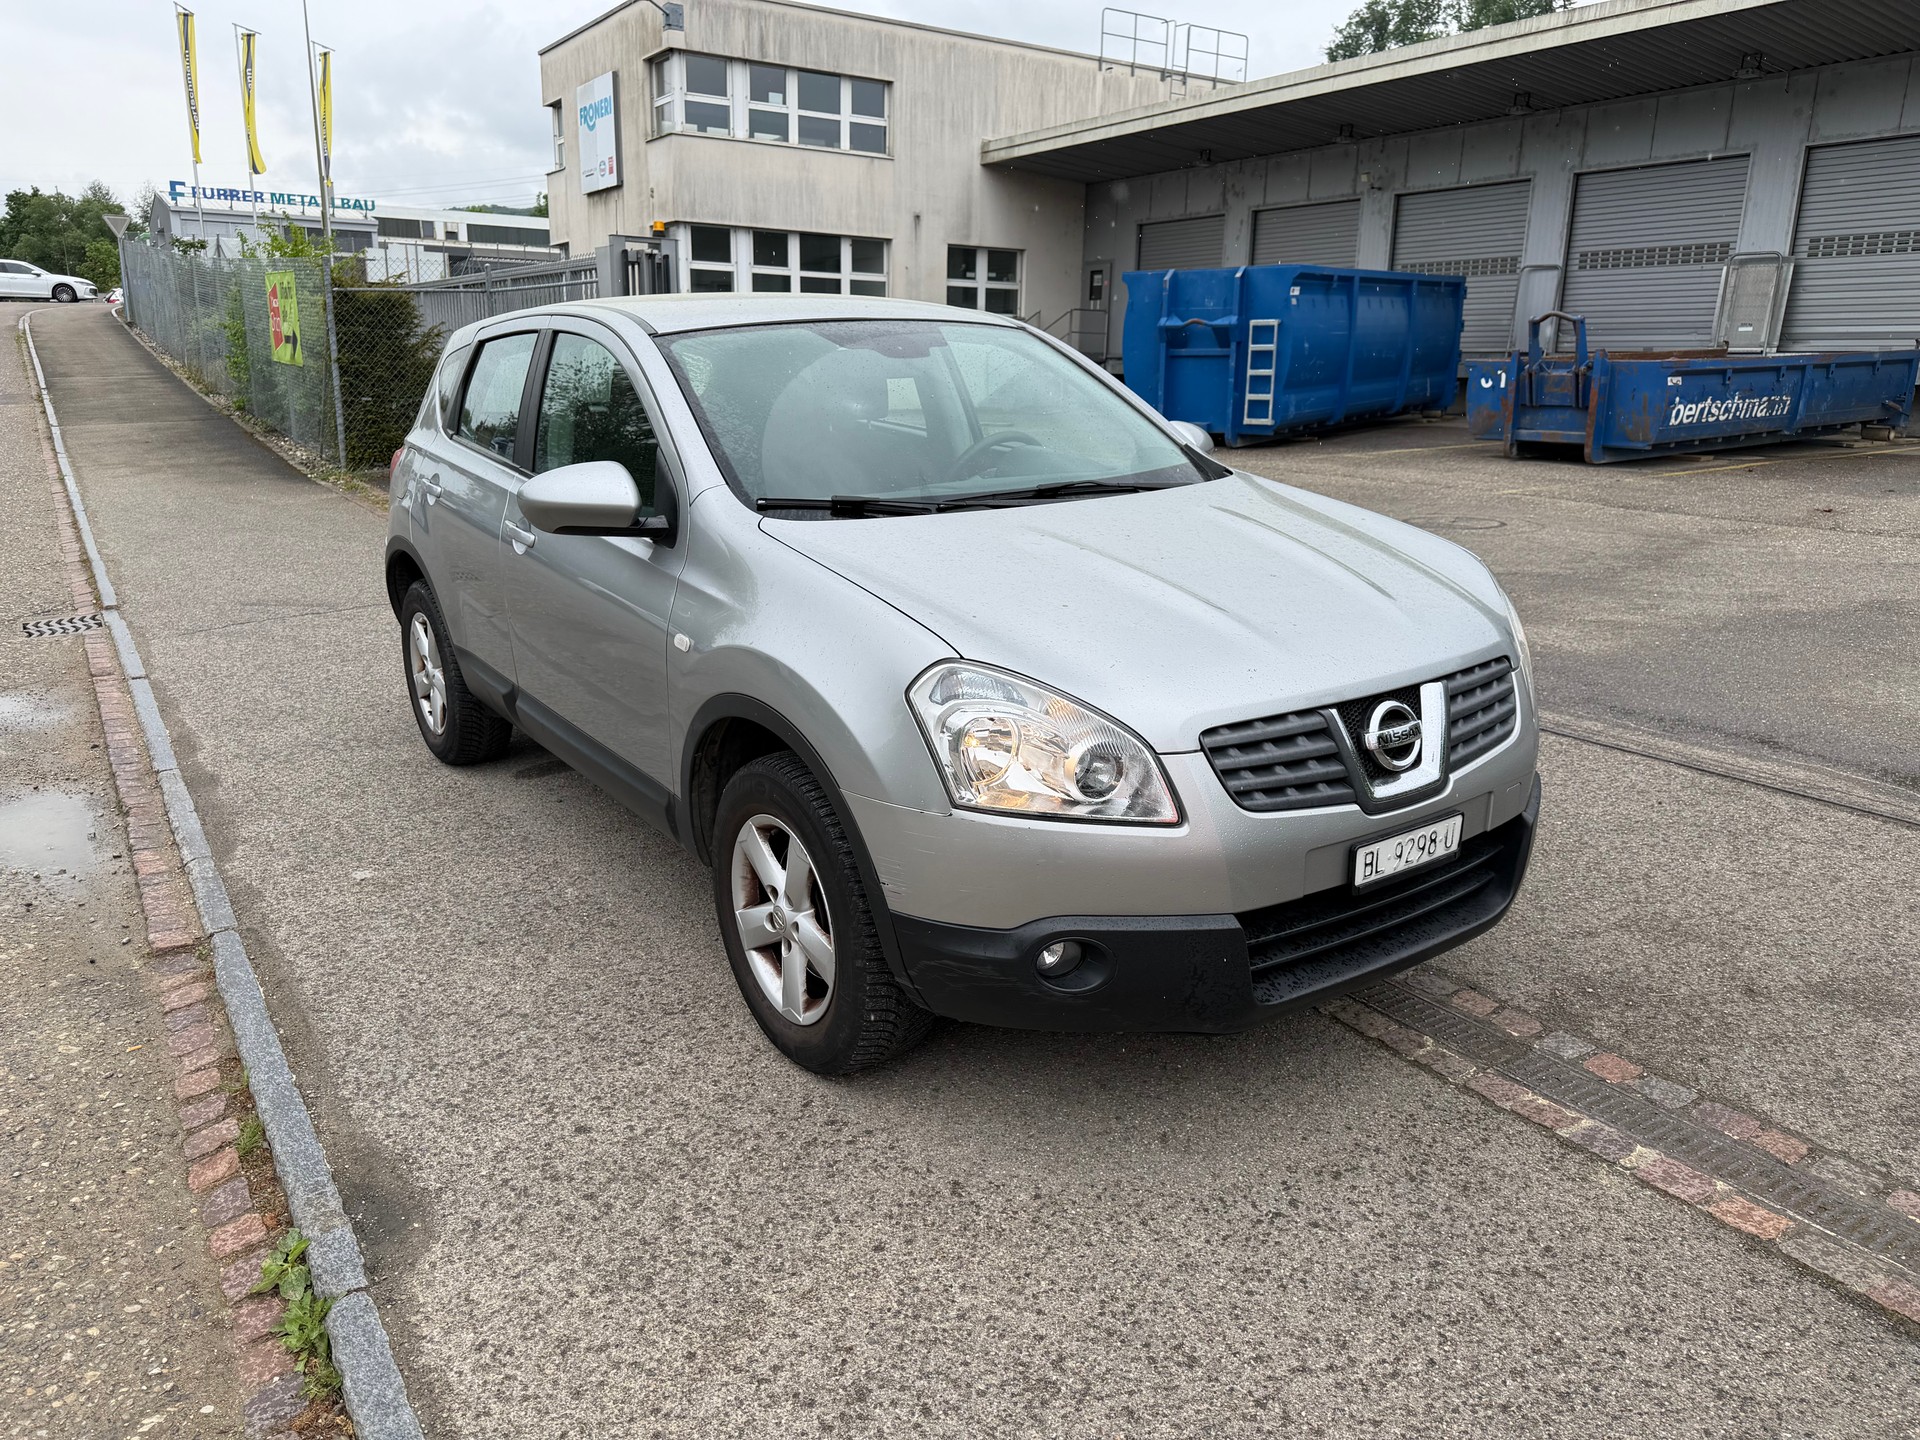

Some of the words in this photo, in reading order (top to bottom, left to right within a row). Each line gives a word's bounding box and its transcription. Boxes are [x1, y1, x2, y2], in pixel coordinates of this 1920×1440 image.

[579, 95, 612, 131] FRONERI
[1377, 727, 1421, 746] NISSAN
[1363, 847, 1385, 880] BL
[1393, 828, 1438, 871] 9298
[1443, 821, 1456, 851] U
